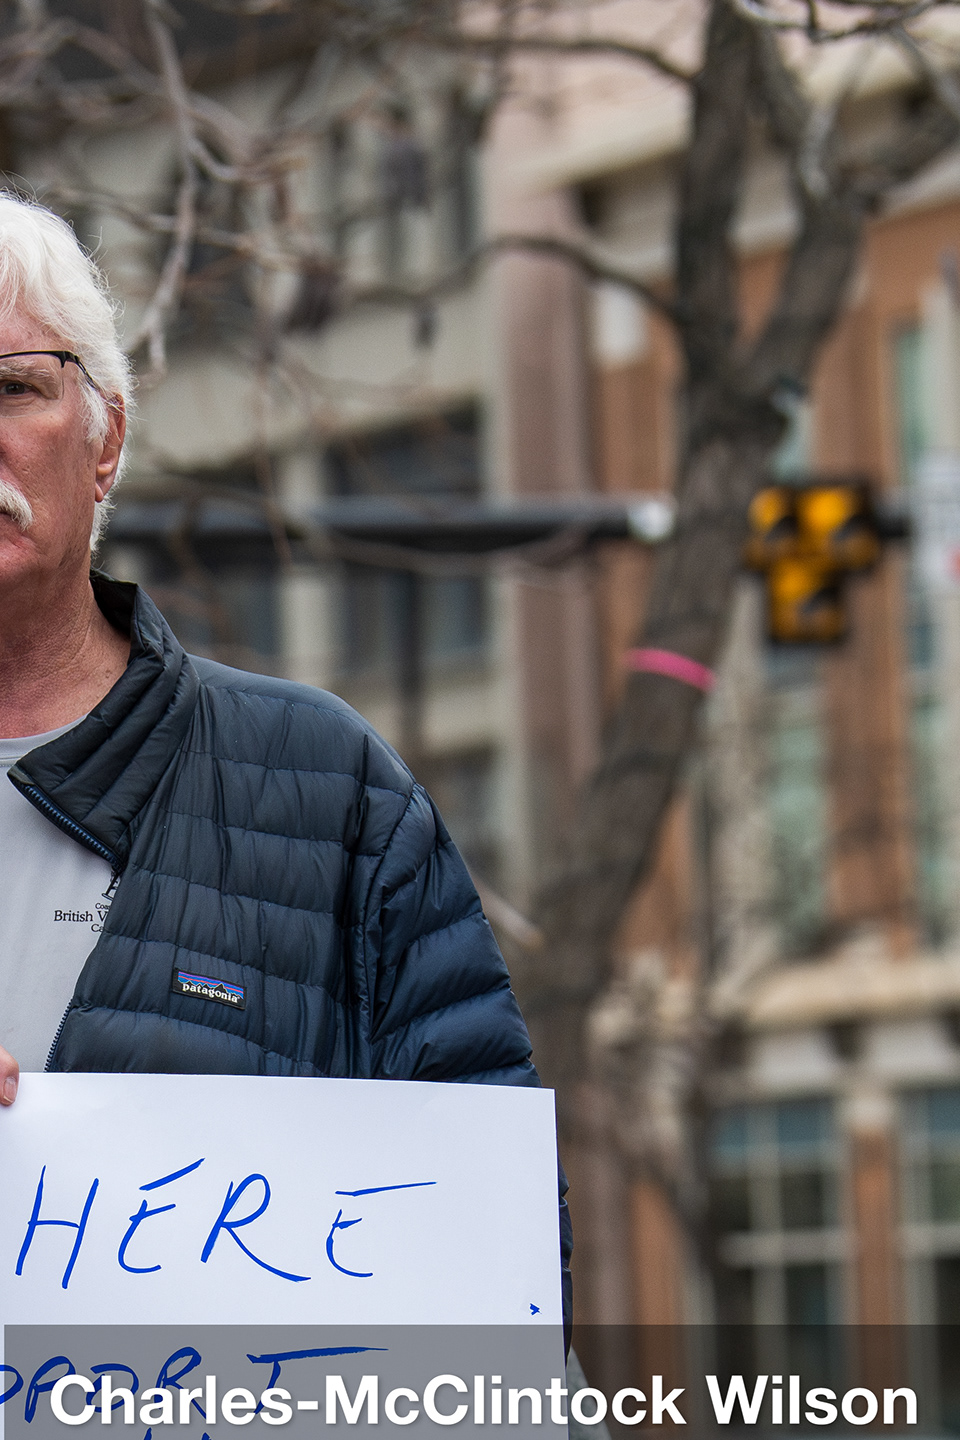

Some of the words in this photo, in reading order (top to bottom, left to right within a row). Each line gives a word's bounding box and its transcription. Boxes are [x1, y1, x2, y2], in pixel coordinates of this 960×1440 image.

[53, 909, 94, 922] British
[182, 983, 239, 1004] patagonia
[14, 1157, 438, 1290] HERE
